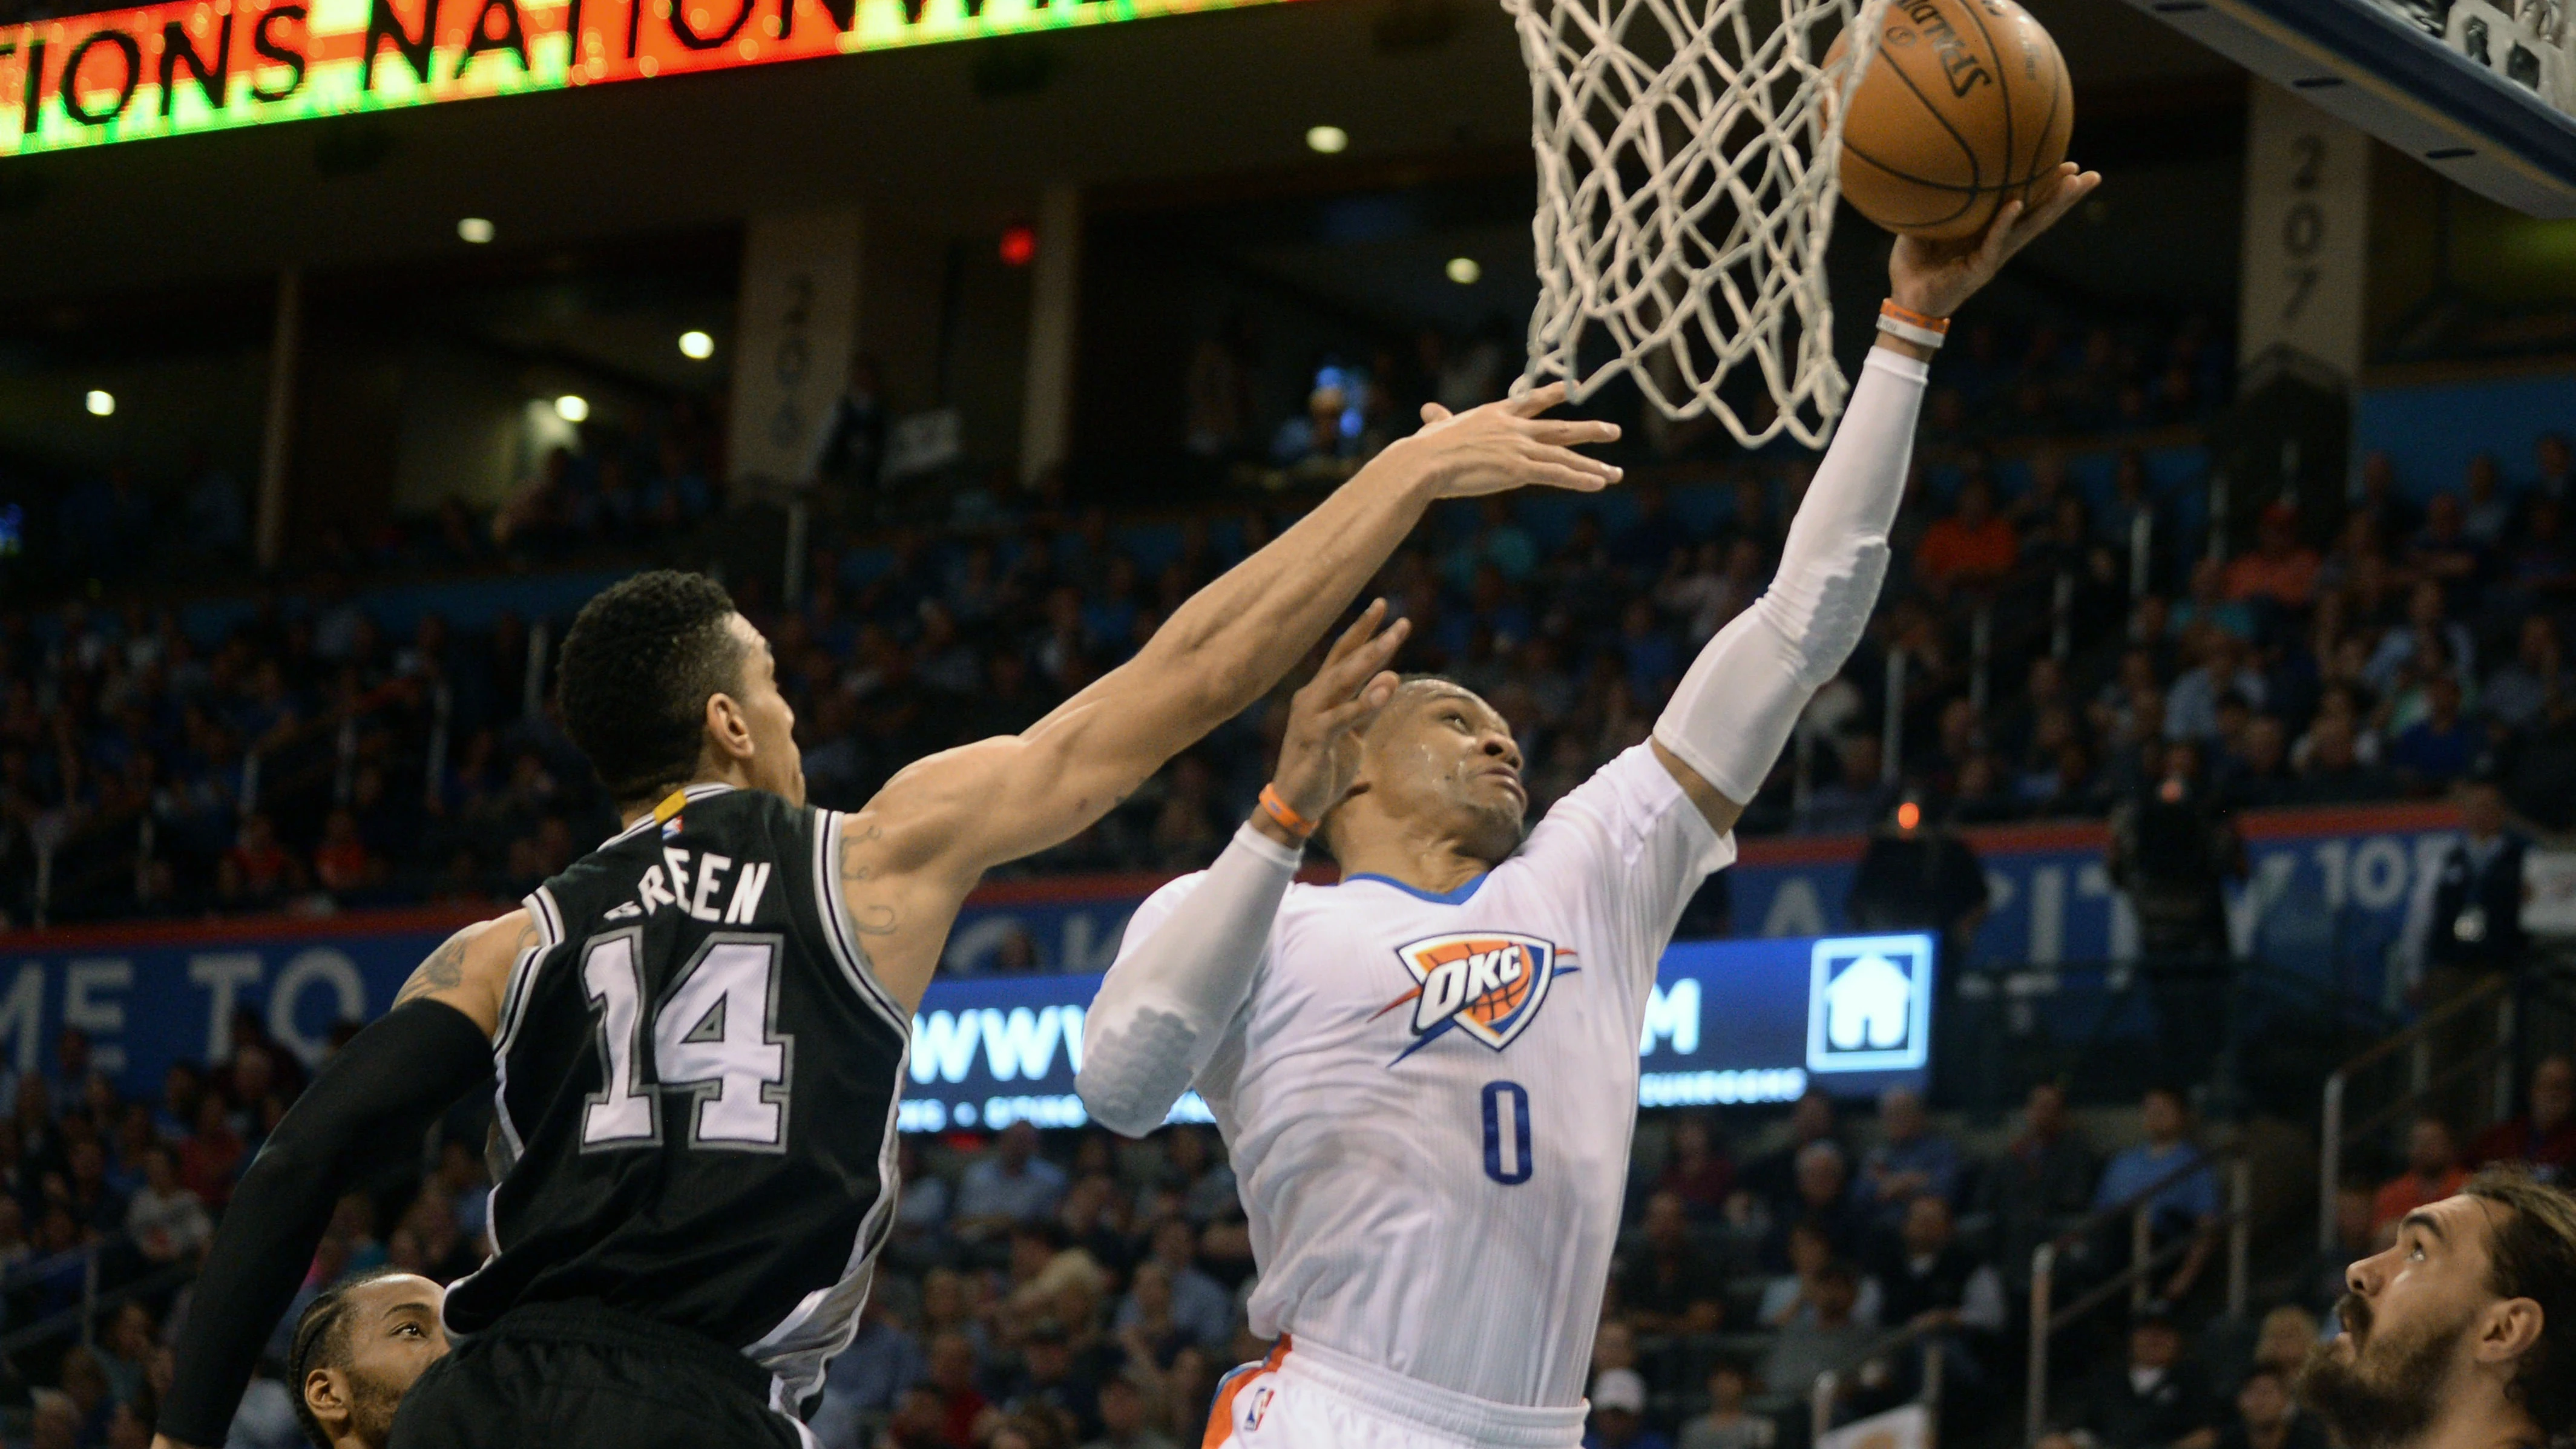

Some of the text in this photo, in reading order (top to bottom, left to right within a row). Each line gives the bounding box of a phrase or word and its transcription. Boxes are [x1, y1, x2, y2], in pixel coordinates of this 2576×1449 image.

[603, 847, 771, 924] GREEN
[188, 947, 367, 1071] TO
[579, 925, 794, 1155] 14
[1417, 944, 1523, 1030] OKC
[1480, 1079, 1533, 1186] 0
